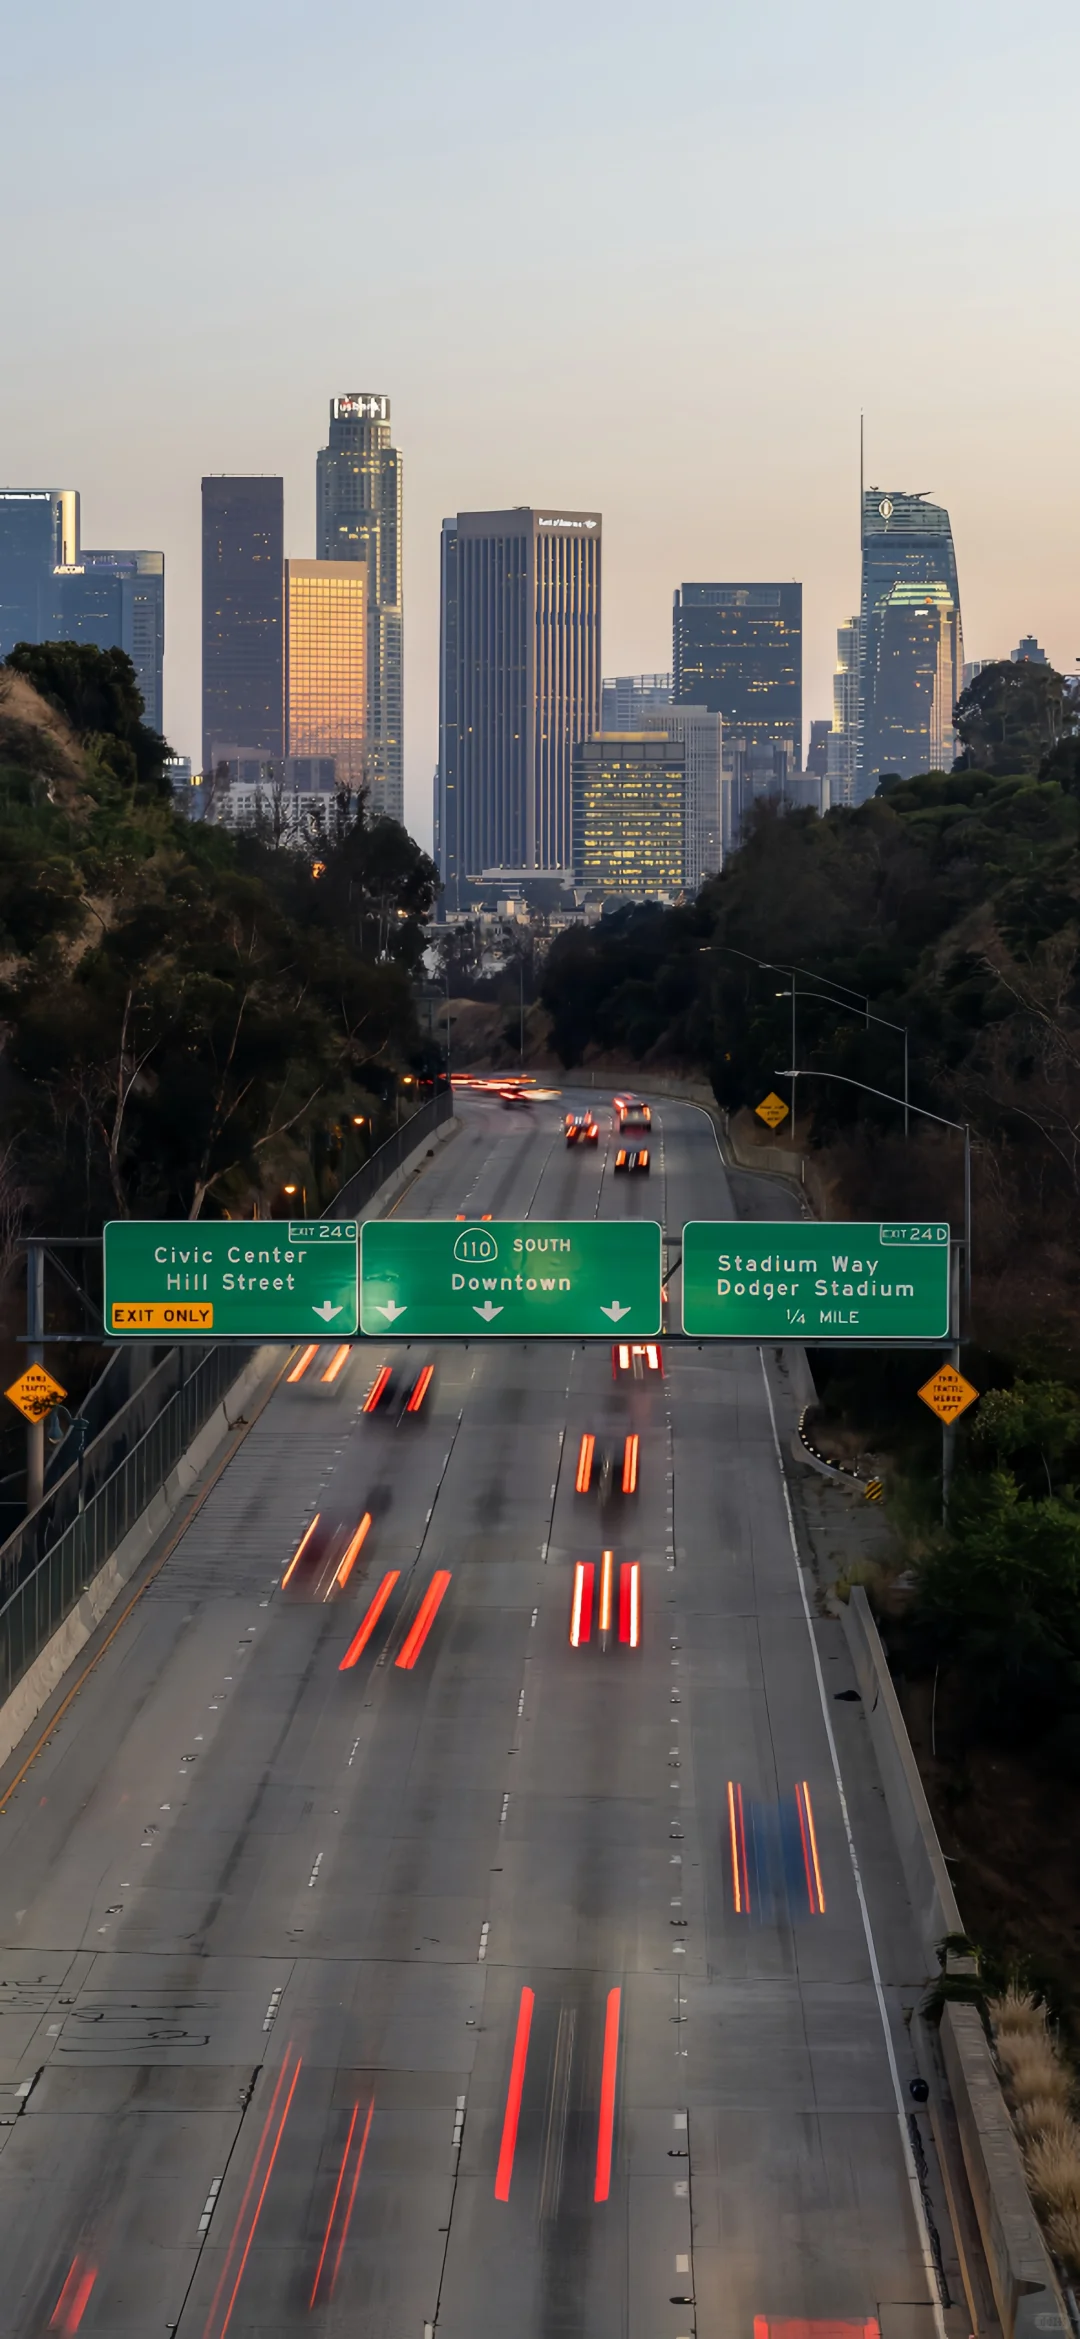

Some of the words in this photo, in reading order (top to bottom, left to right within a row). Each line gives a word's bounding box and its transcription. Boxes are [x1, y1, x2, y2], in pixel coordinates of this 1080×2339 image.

[291, 1227, 315, 1236] EXIT
[882, 1229, 907, 1239] EXIT
[462, 1241, 491, 1257] 110
[513, 1238, 571, 1252] SOUTH
[154, 1246, 213, 1263] Civic
[227, 1246, 307, 1263] Center
[717, 1254, 818, 1273] Stadium
[831, 1255, 879, 1277] Way
[166, 1273, 208, 1291] Hill
[222, 1273, 295, 1291] Street
[451, 1272, 571, 1291] Downtown
[717, 1278, 800, 1301] Dodger
[814, 1279, 914, 1297] Stadium
[114, 1309, 154, 1322] EXIT
[163, 1309, 210, 1322] ONLY
[819, 1310, 860, 1324] MILE
